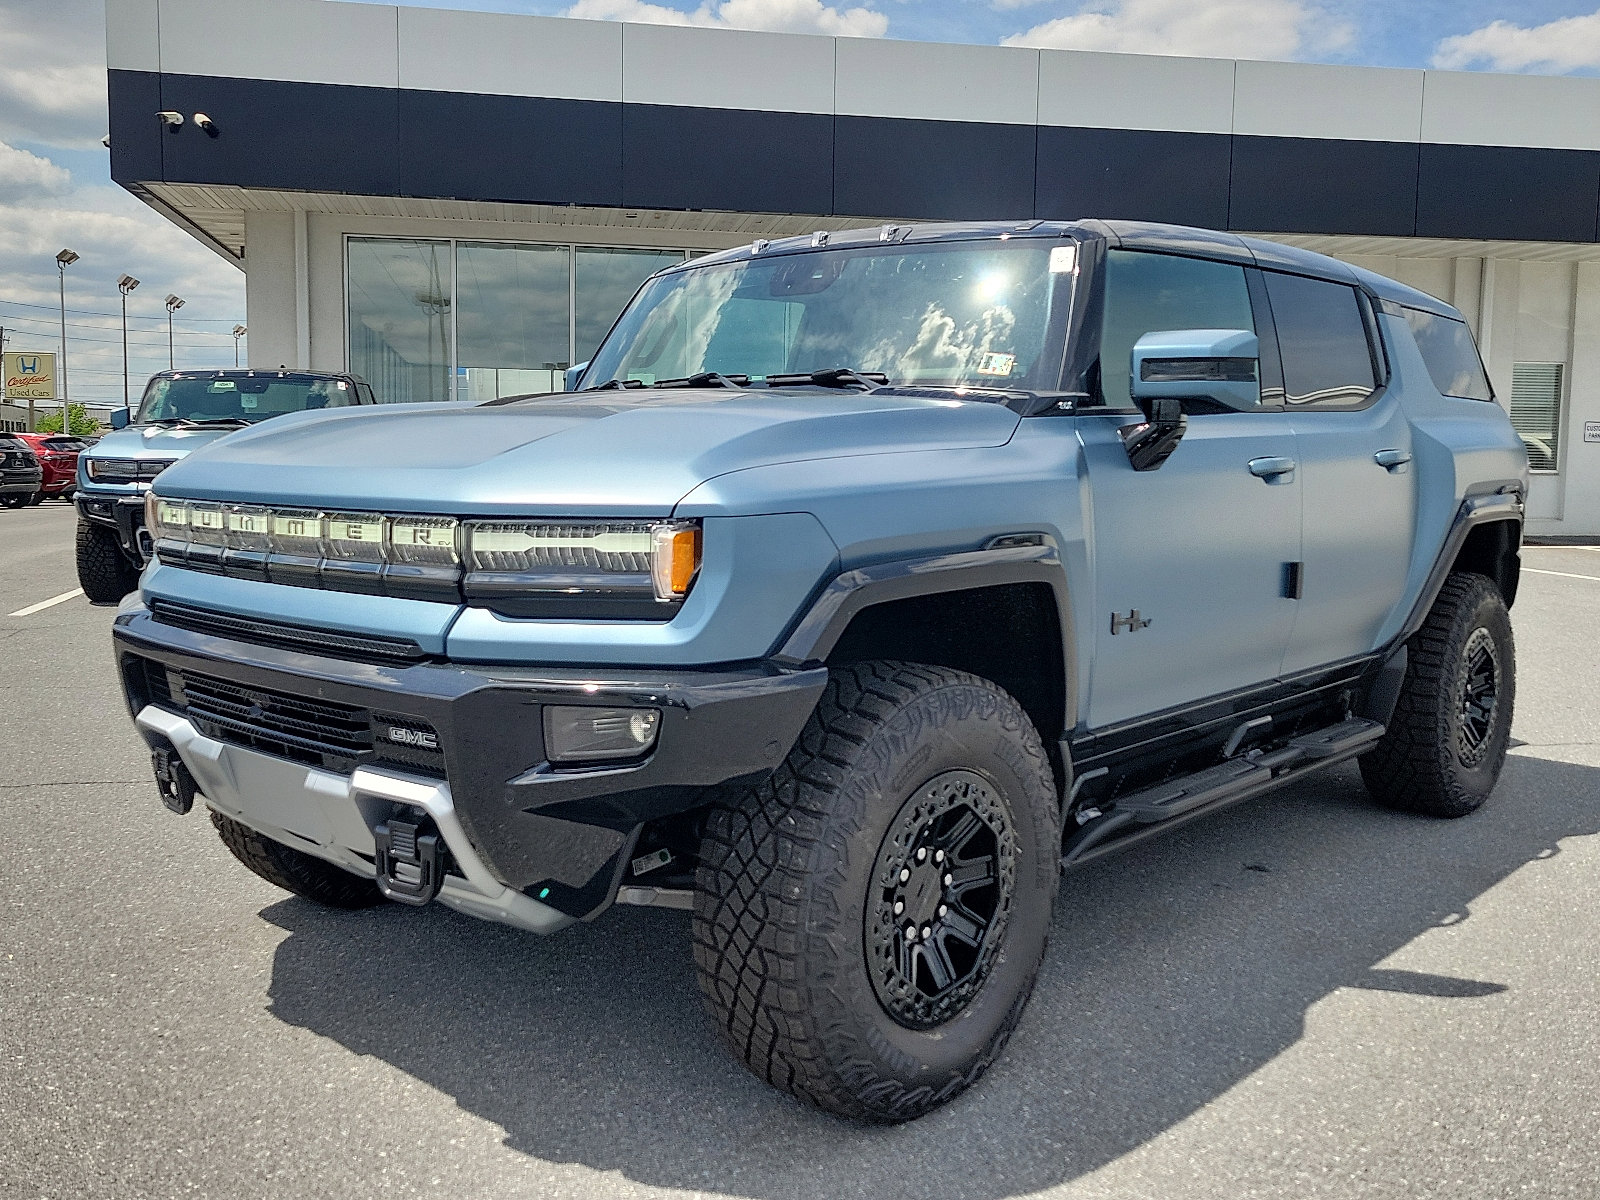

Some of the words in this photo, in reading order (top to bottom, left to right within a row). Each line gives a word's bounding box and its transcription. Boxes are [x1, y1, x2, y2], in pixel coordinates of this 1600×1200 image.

[7, 374, 51, 387] Certified
[169, 507, 432, 545] HUMMER
[389, 726, 438, 748] GMC
